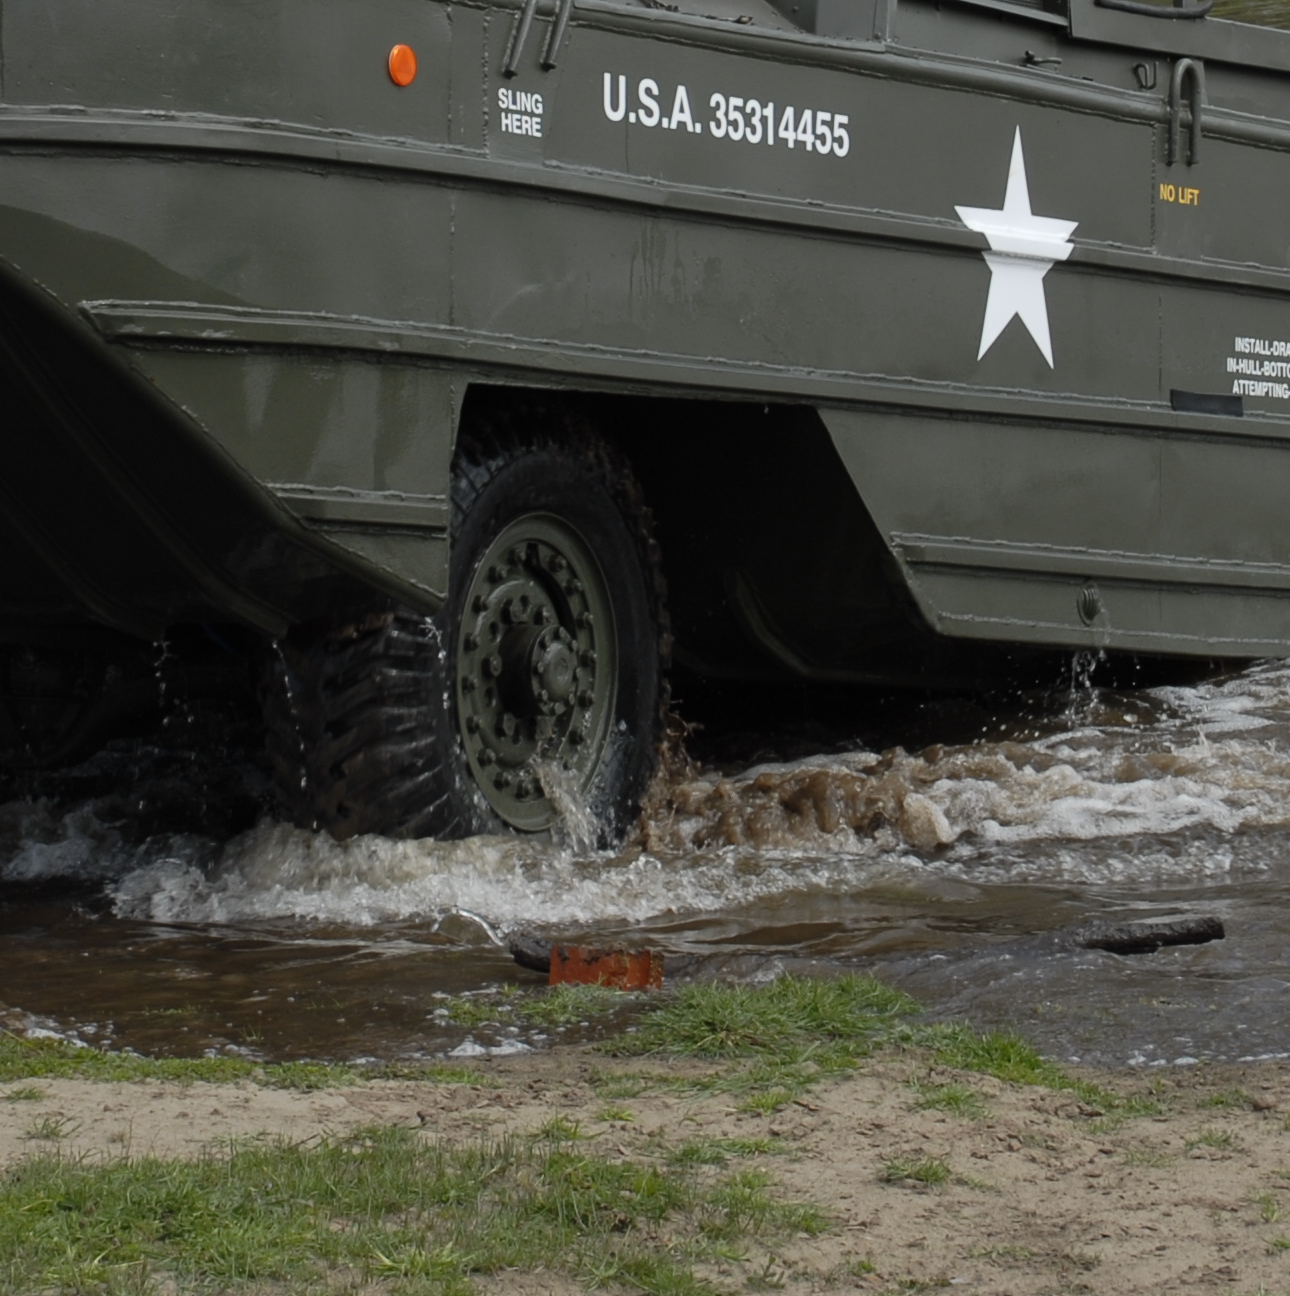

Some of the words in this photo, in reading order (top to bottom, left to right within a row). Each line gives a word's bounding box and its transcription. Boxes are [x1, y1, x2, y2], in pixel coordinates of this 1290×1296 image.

[498, 87, 543, 115] SLING
[501, 112, 542, 138] HERE
[603, 72, 702, 134] U.S.A.
[709, 92, 850, 158] 35314455
[1160, 183, 1176, 202] NO
[1179, 186, 1200, 206] LIFT
